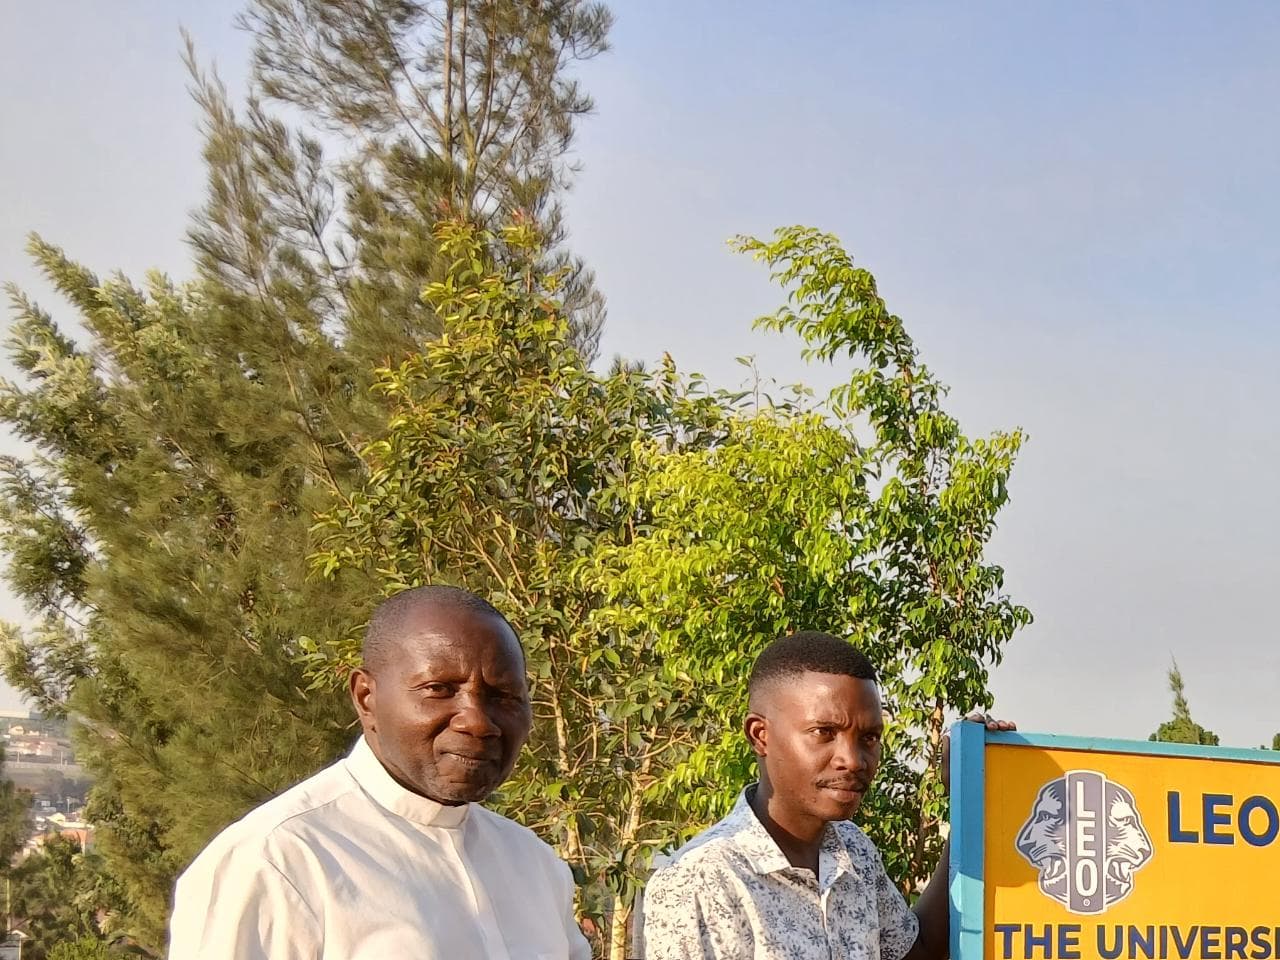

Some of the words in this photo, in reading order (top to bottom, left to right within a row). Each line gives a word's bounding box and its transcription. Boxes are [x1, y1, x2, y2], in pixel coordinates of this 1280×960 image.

[1075, 781, 1098, 897] LEO
[1167, 791, 1280, 847] LEO
[994, 923, 1081, 960] THE
